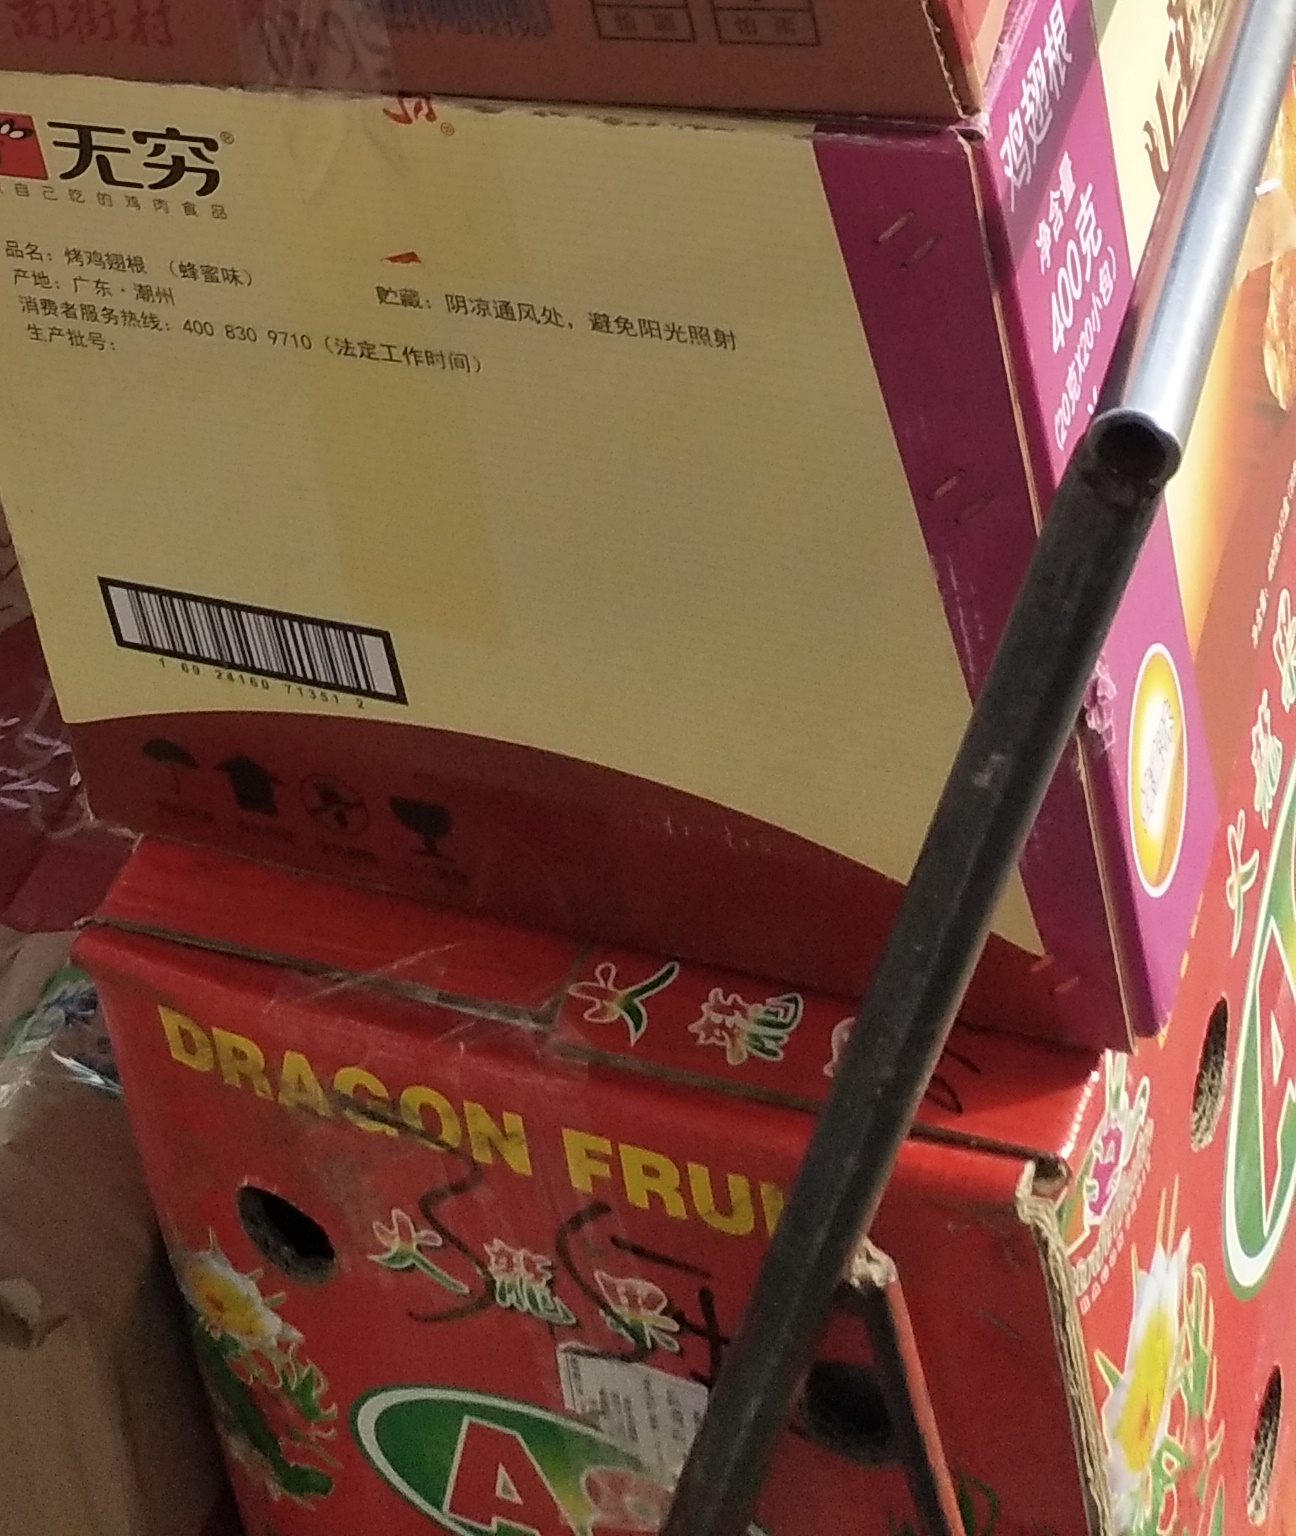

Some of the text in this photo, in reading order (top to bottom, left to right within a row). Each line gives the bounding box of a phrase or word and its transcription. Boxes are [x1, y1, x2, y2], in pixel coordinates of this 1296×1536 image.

[46, 119, 223, 197] 无穷
[1035, 150, 1077, 275] 净含量
[63, 244, 149, 275] 烤鸡翅根
[1051, 182, 1103, 354] 400克
[182, 318, 215, 338] 400
[225, 323, 258, 344] 830
[267, 327, 313, 351] 9710
[587, 311, 738, 352] 避免阳光照射
[156, 1001, 534, 1177] DRAGON
